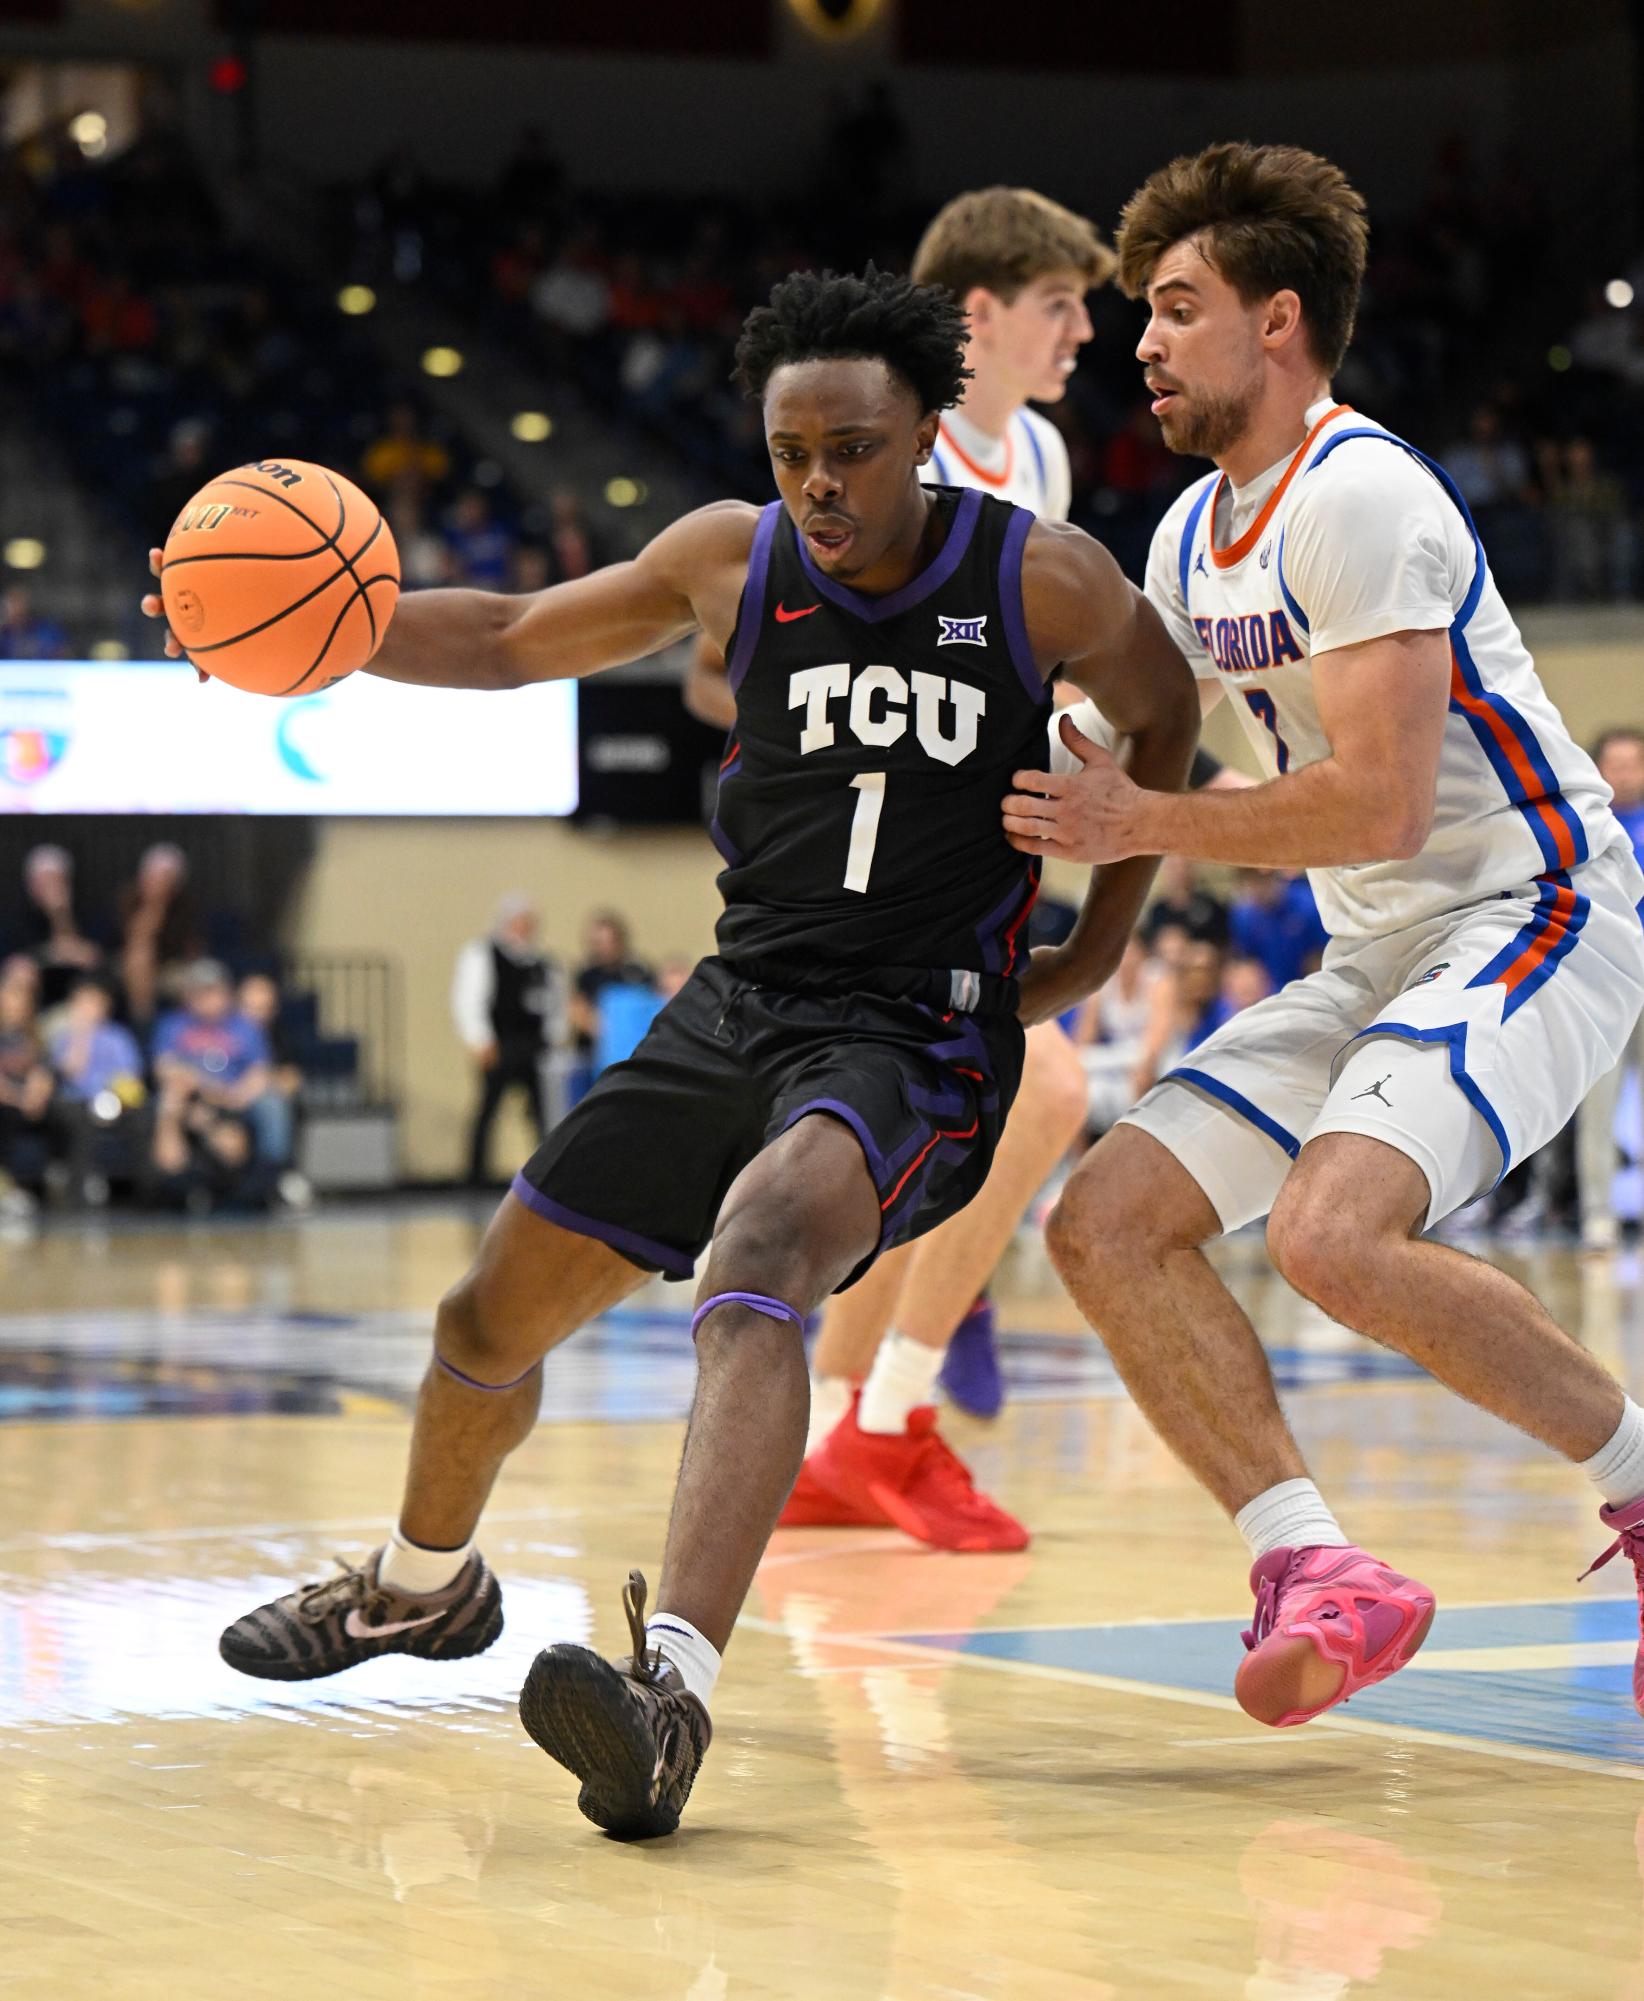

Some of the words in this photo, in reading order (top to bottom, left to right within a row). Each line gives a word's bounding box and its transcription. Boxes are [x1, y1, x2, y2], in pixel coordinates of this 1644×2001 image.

[245, 462, 302, 488] on
[940, 618, 985, 644] XII
[1193, 609, 1305, 672] FLORIDA
[789, 663, 986, 767] TCU
[1243, 688, 1289, 775] 7
[843, 771, 886, 894] 1
